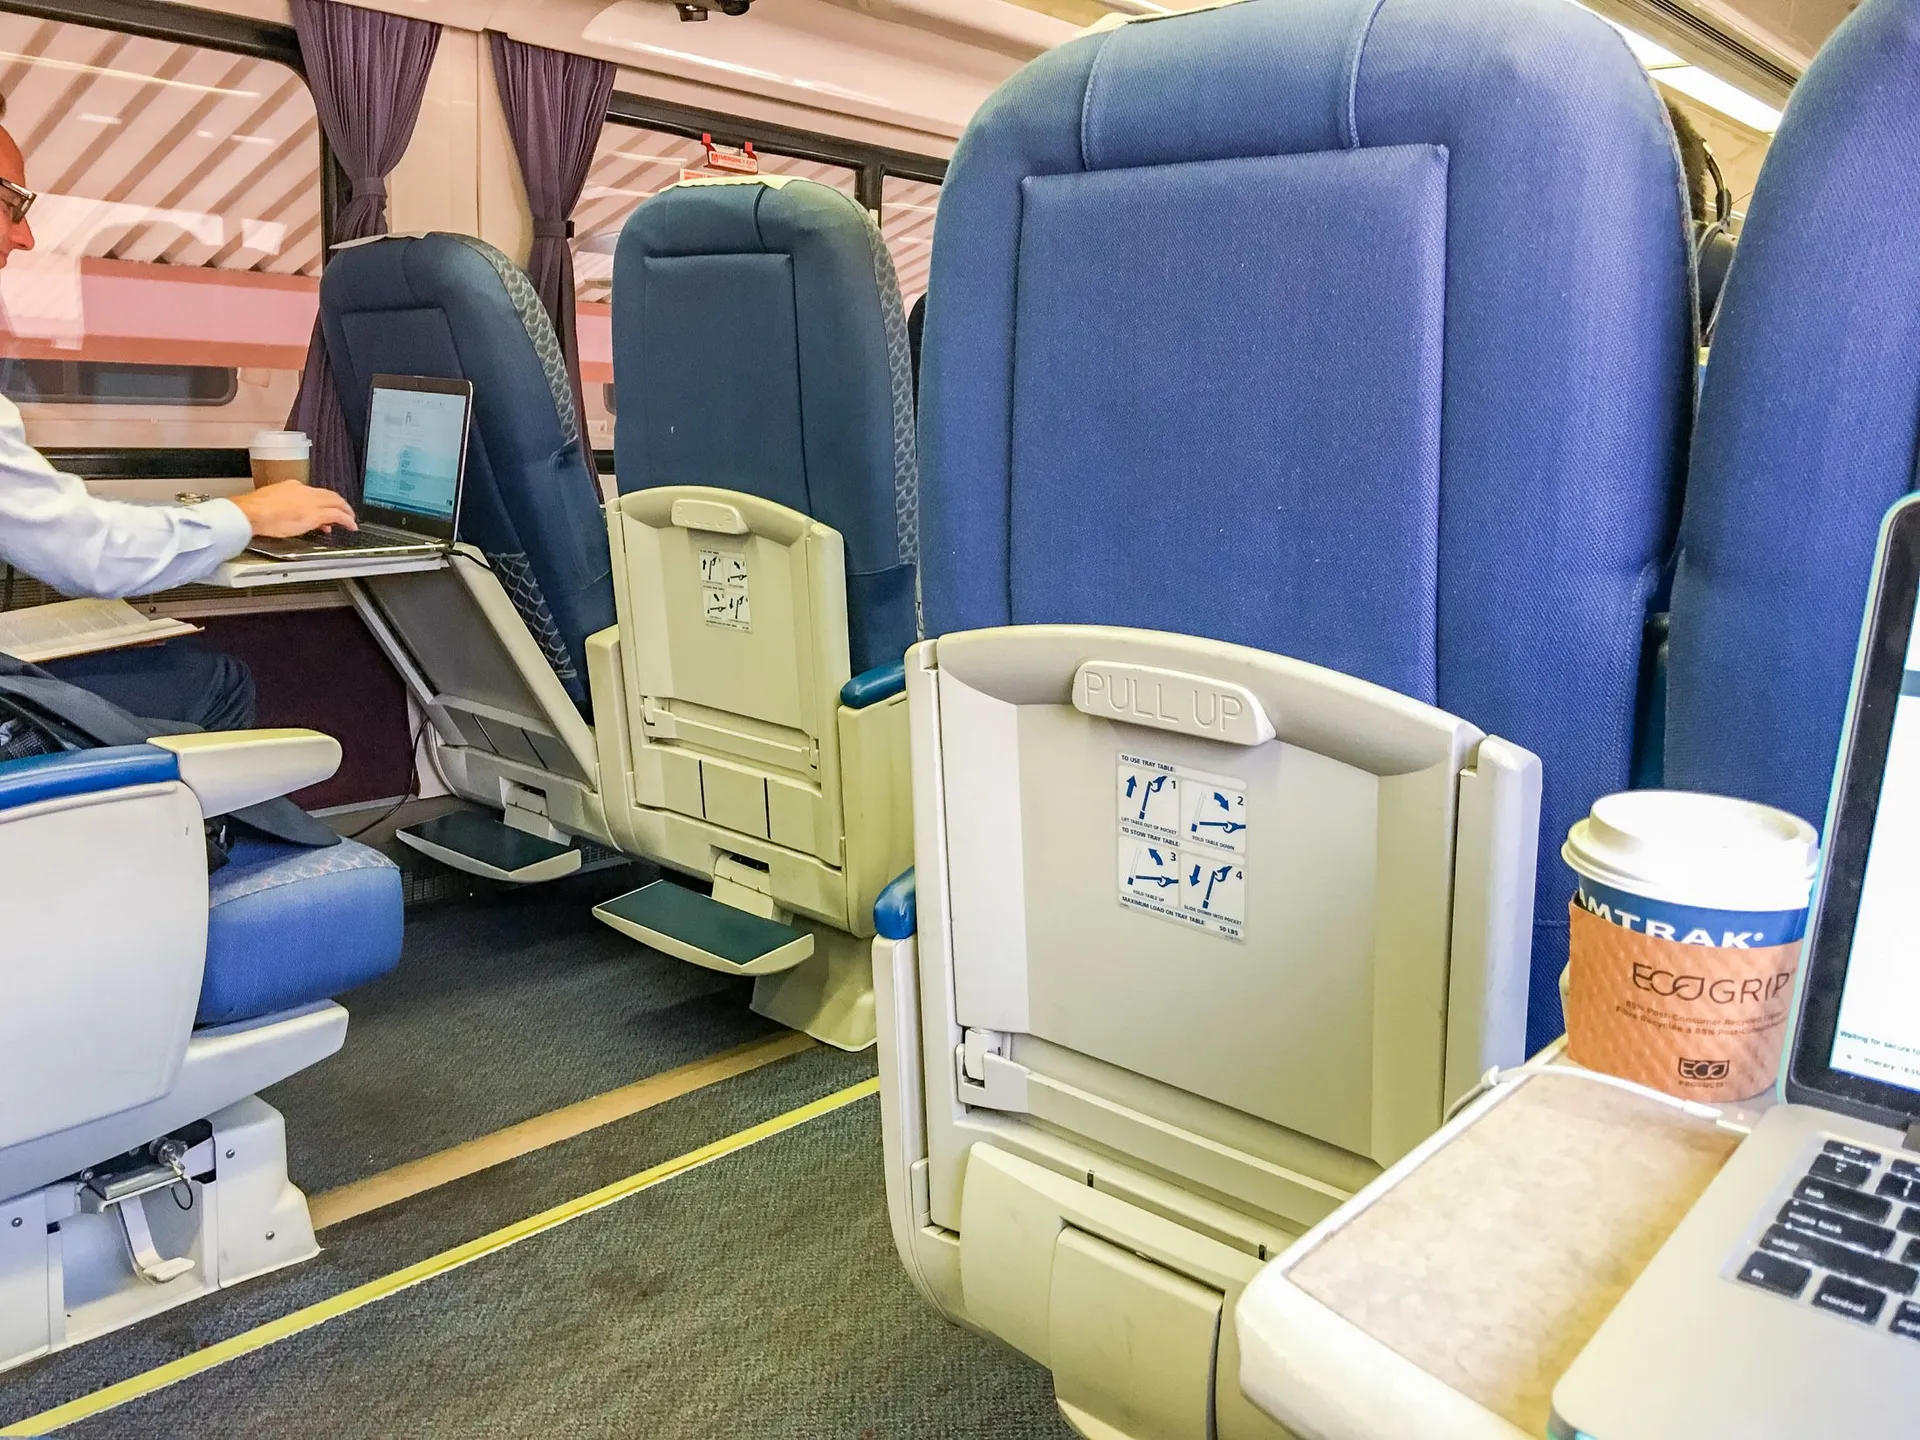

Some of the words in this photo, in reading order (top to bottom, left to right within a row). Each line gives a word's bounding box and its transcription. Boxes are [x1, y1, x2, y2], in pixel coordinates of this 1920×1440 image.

[1083, 670, 1179, 723] PULL
[1192, 689, 1243, 732] UP
[1130, 757, 1140, 765] USE
[1142, 760, 1156, 768] TRAY
[1171, 780, 1176, 790] 1
[1237, 796, 1244, 806] 2
[1131, 818, 1143, 827] TABLE
[1160, 827, 1177, 835] POCKET
[1130, 829, 1146, 838] STOW
[1147, 833, 1162, 842] TRAY
[1205, 839, 1218, 847] TABLE
[1219, 842, 1235, 851] DOWN
[1170, 852, 1177, 861] 3
[1235, 870, 1243, 880] 4
[1133, 889, 1144, 897] FOLD
[1145, 892, 1158, 901] TABLE
[1122, 896, 1149, 909] MAXIMUM
[1150, 904, 1165, 913] LOAD
[1165, 908, 1174, 916] ON
[1175, 911, 1188, 920] TRAY
[1227, 928, 1239, 936] LBS
[1184, 904, 1196, 912] SLIDE
[1197, 908, 1212, 917] DOWN
[1224, 916, 1242, 925] POCKET
[1646, 1007, 1721, 1025] Post-Consumer
[1840, 1030, 1868, 1043] Waiting
[1818, 1220, 1842, 1234] lock
[1821, 1293, 1866, 1315] control
